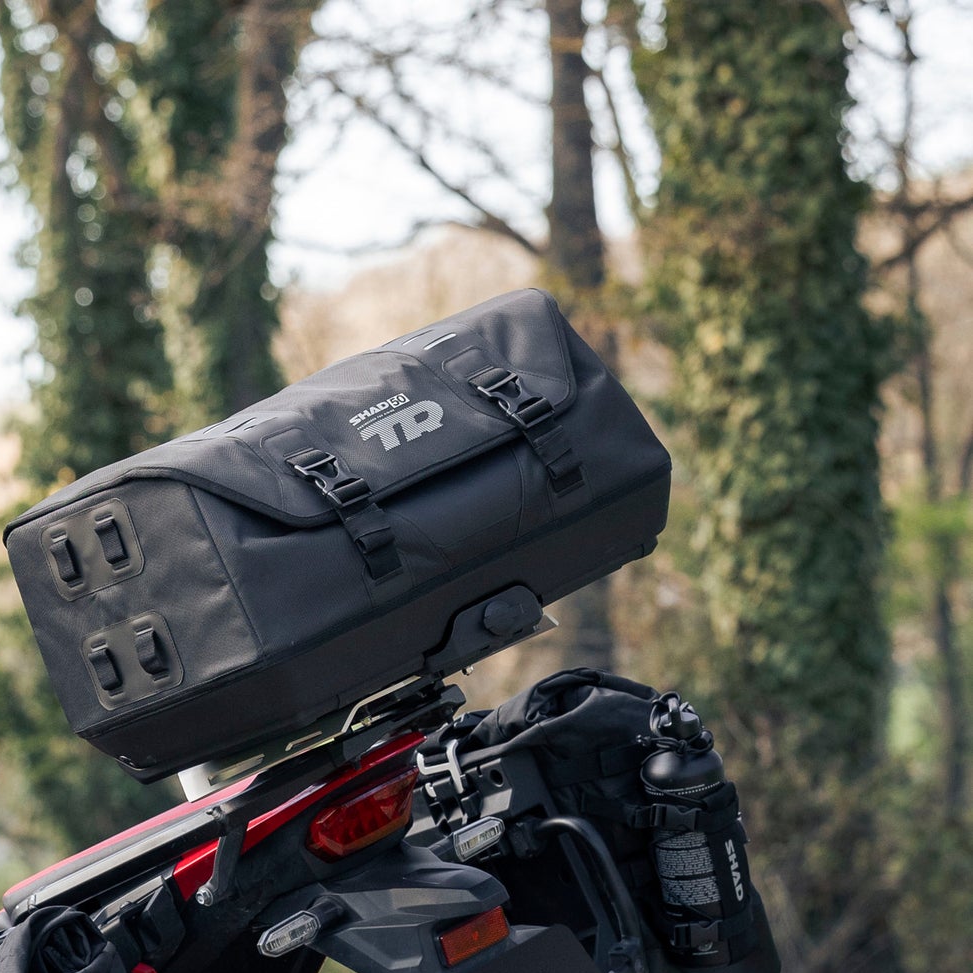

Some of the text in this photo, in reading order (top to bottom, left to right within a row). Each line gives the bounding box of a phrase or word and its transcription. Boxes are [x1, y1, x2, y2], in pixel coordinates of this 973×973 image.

[348, 401, 390, 427] SHAD
[388, 393, 409, 408] 50
[724, 839, 744, 901] SHAD
